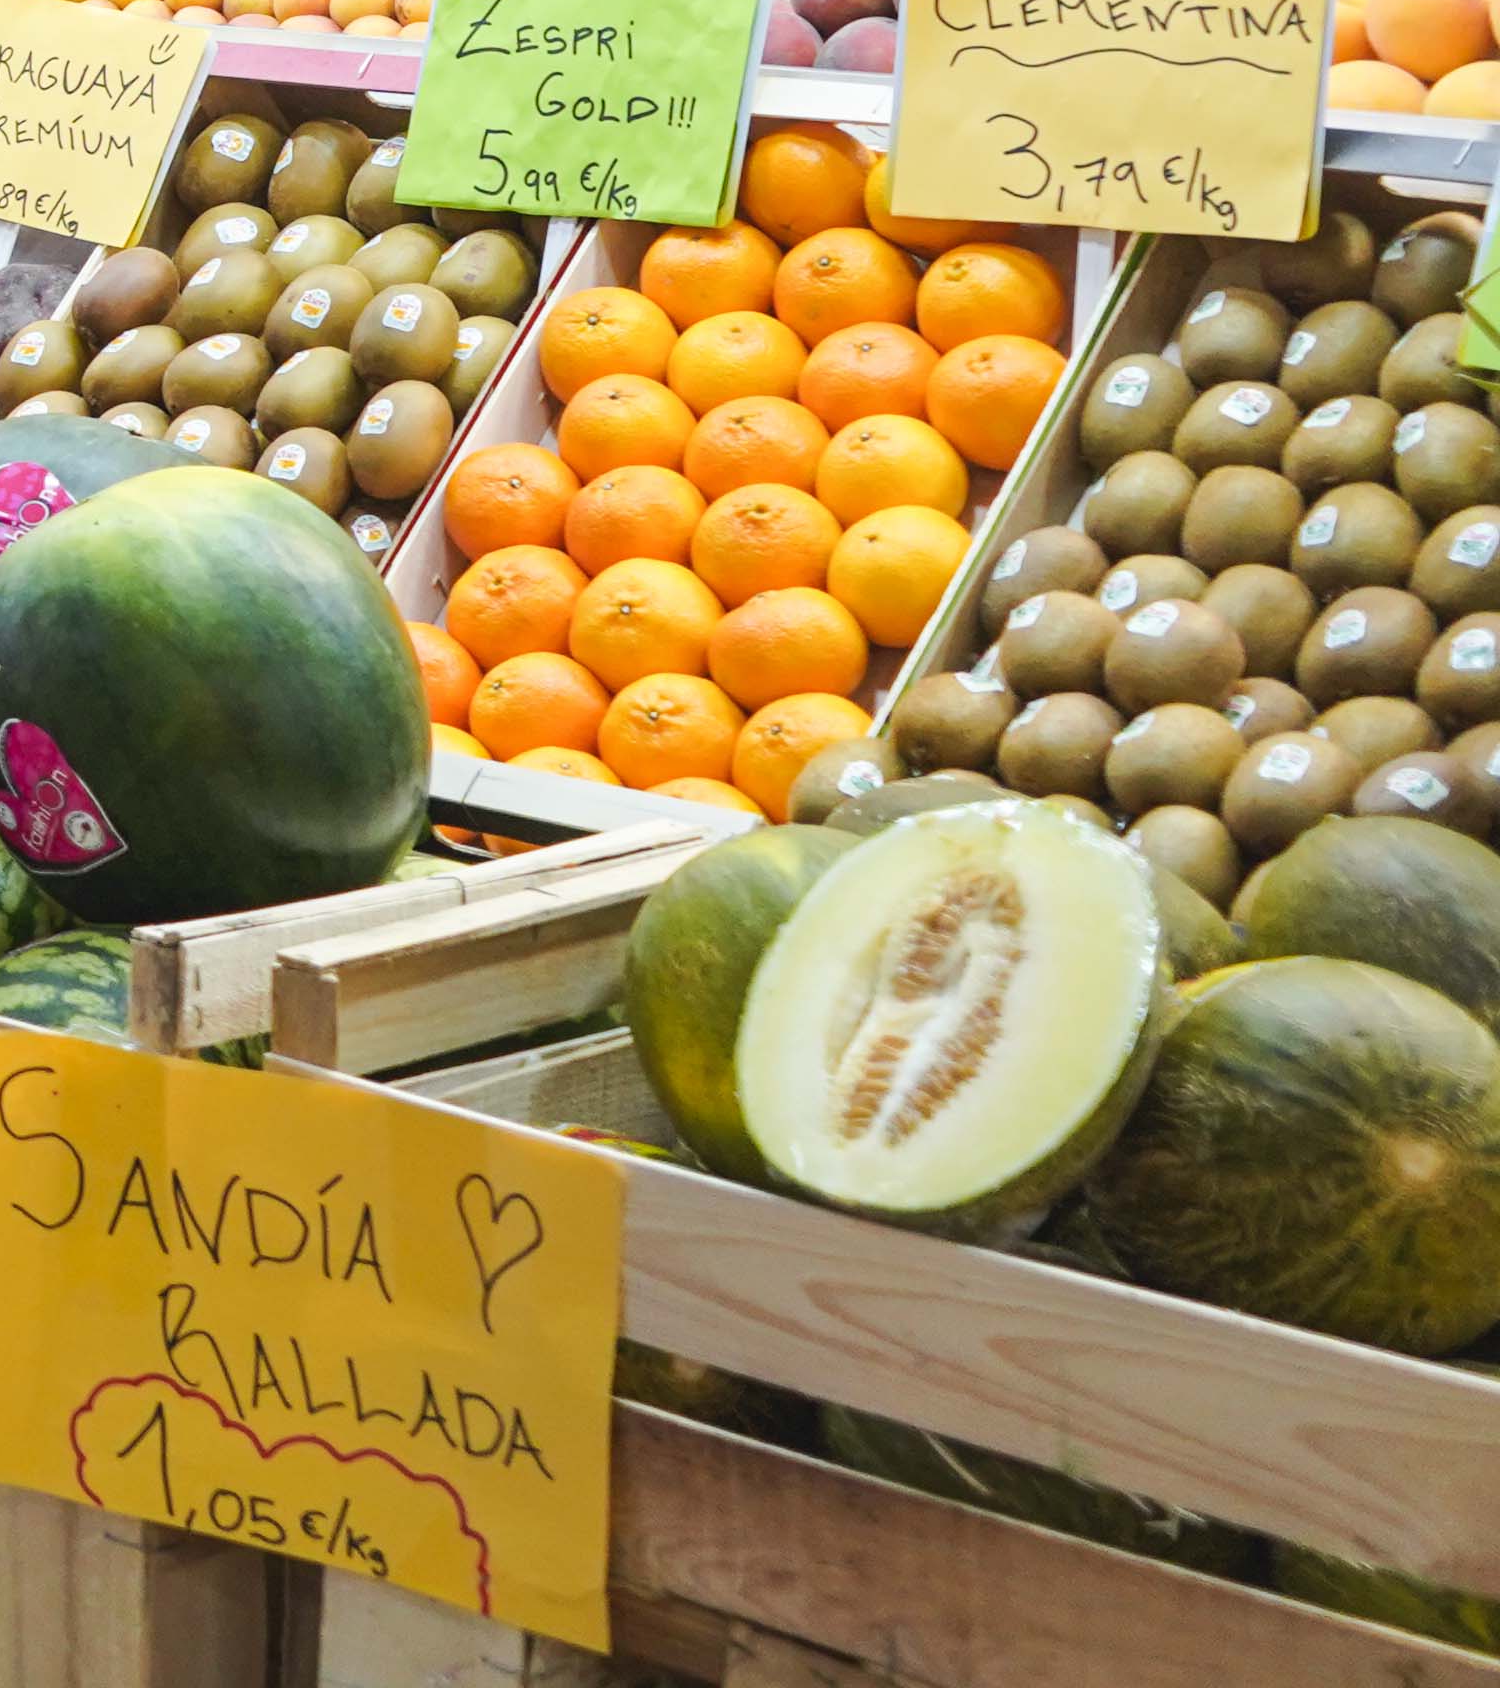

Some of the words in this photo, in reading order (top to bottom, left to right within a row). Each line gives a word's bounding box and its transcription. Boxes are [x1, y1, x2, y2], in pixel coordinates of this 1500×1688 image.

[473, 128, 561, 206] 5,99
[985, 113, 1148, 212] 3,79
[158, 1282, 555, 1481] RALLADA
